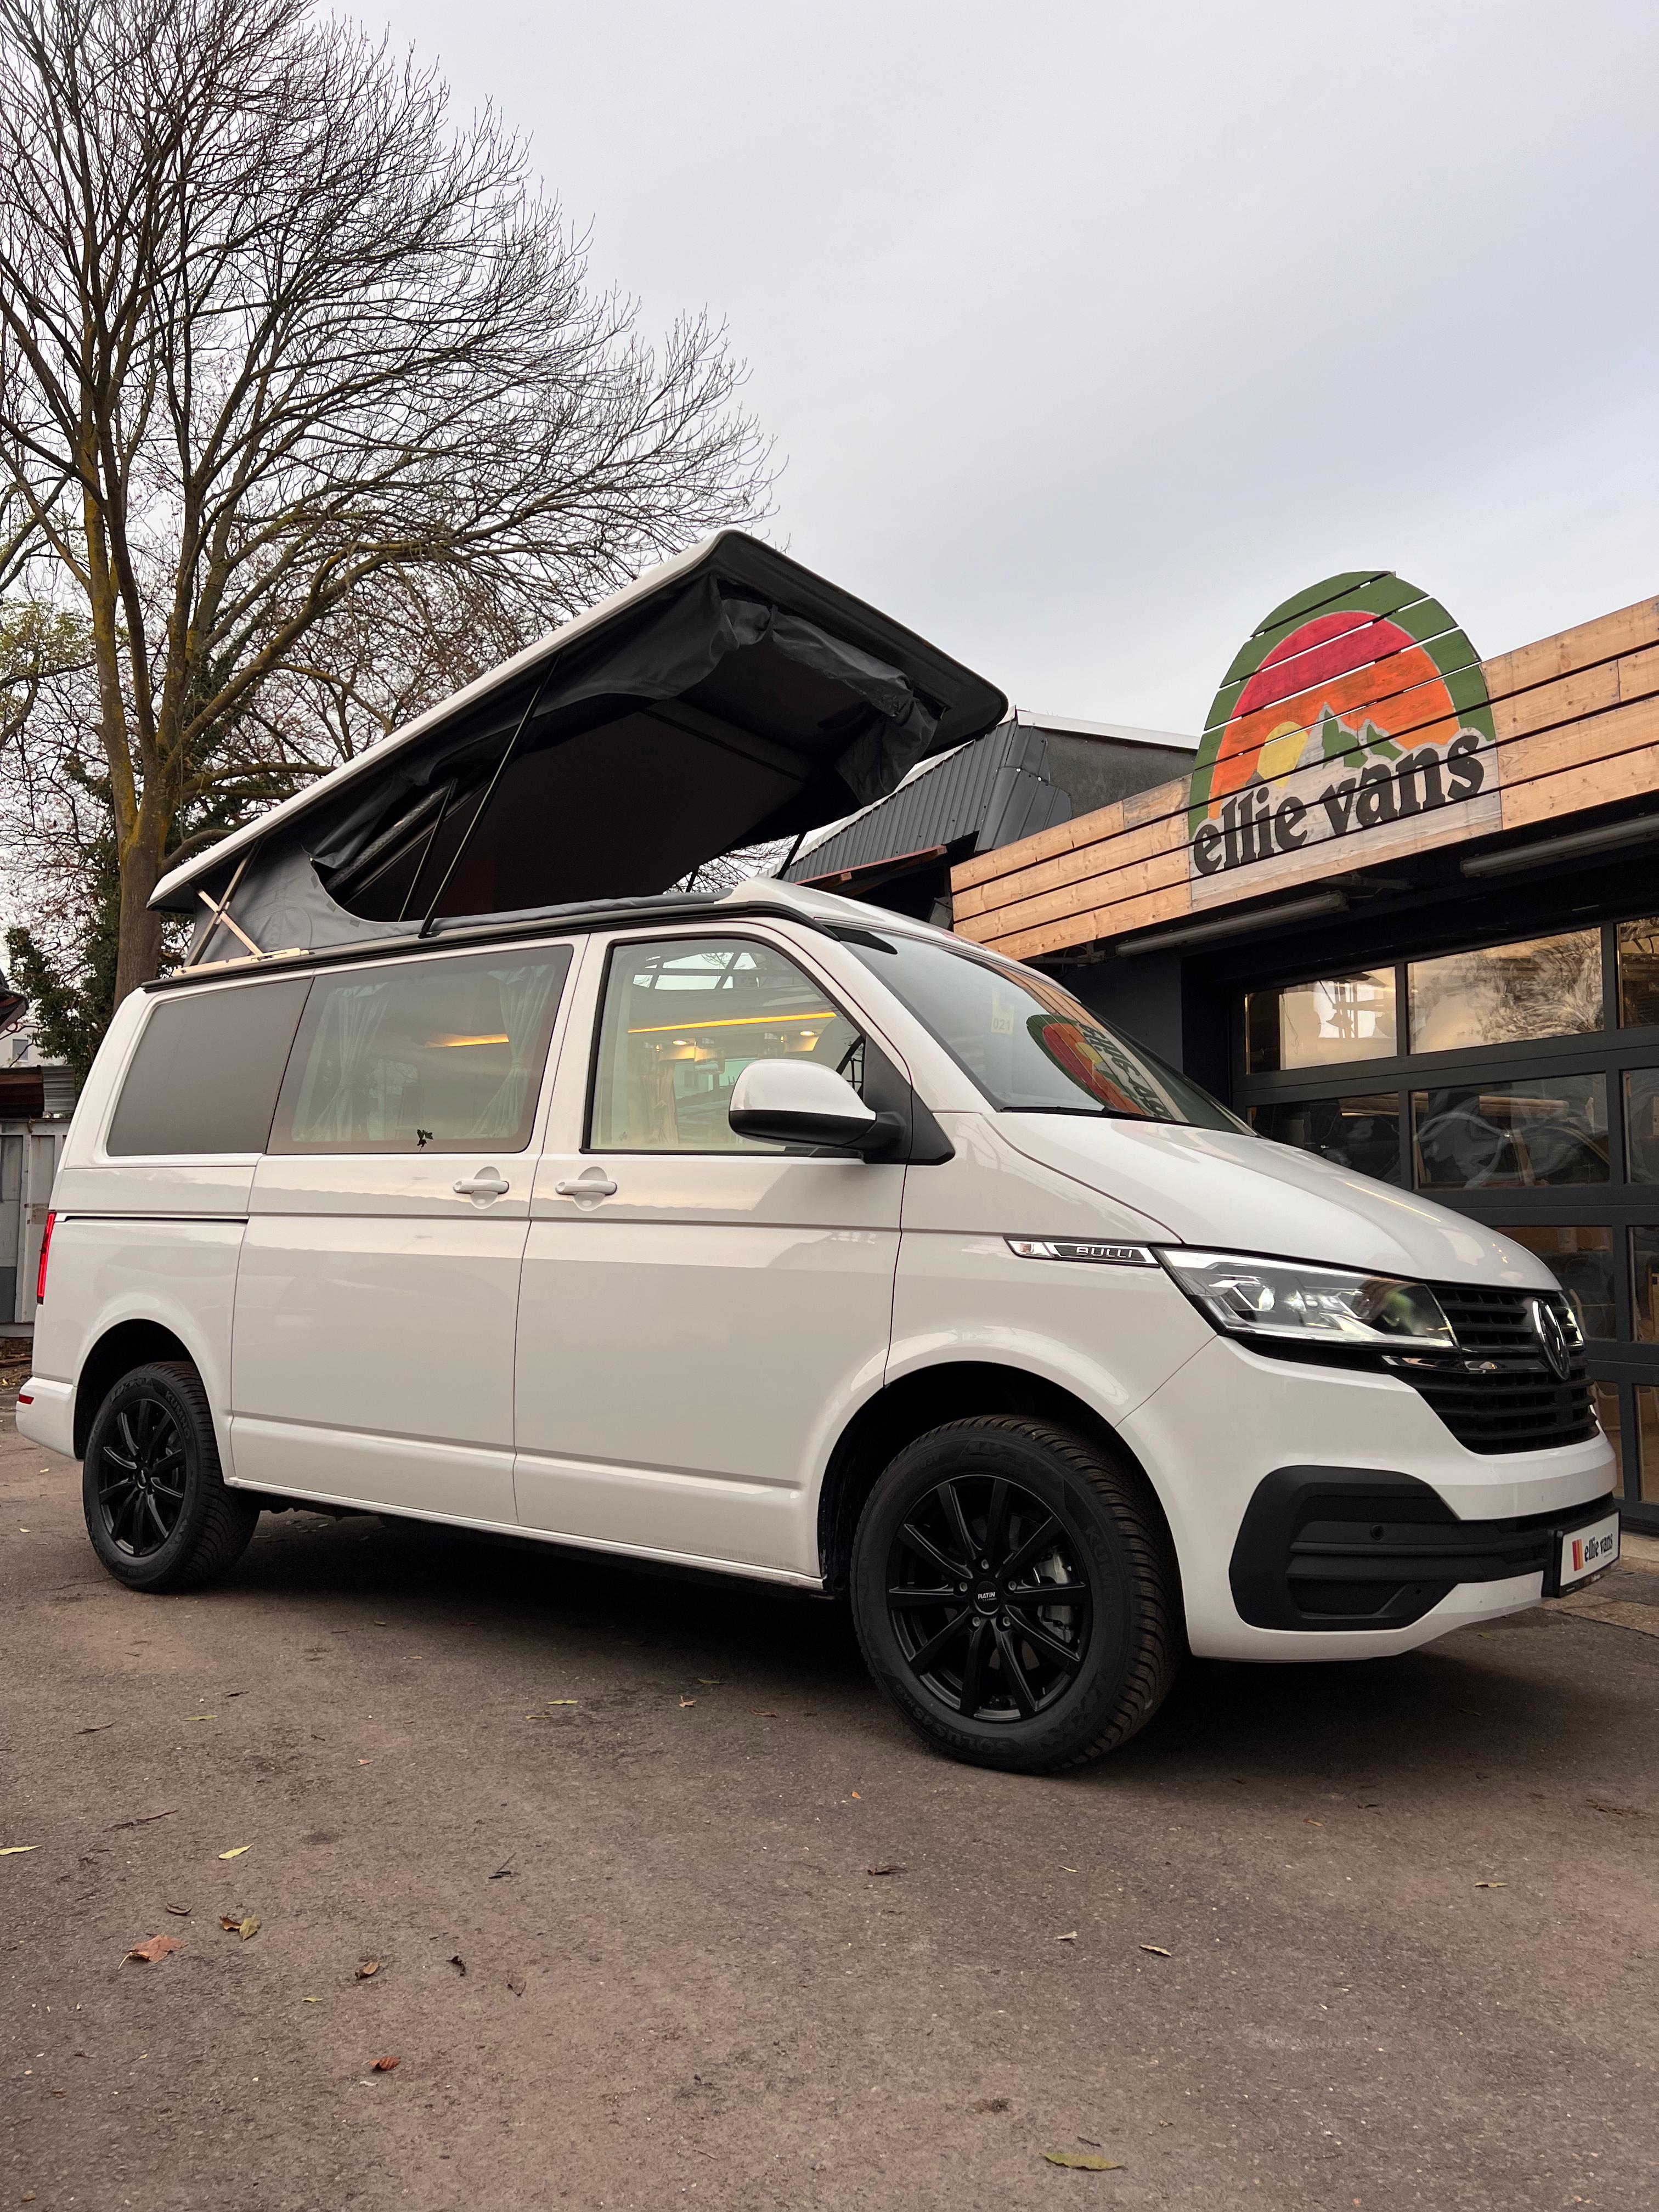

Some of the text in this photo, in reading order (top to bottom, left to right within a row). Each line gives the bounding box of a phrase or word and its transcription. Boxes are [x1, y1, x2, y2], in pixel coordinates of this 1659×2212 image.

[1193, 735, 1485, 875] ellie vans
[993, 1018, 1010, 1031] 021
[1076, 1246, 1133, 1258] BULLI
[1584, 1537, 1599, 1562] ellie
